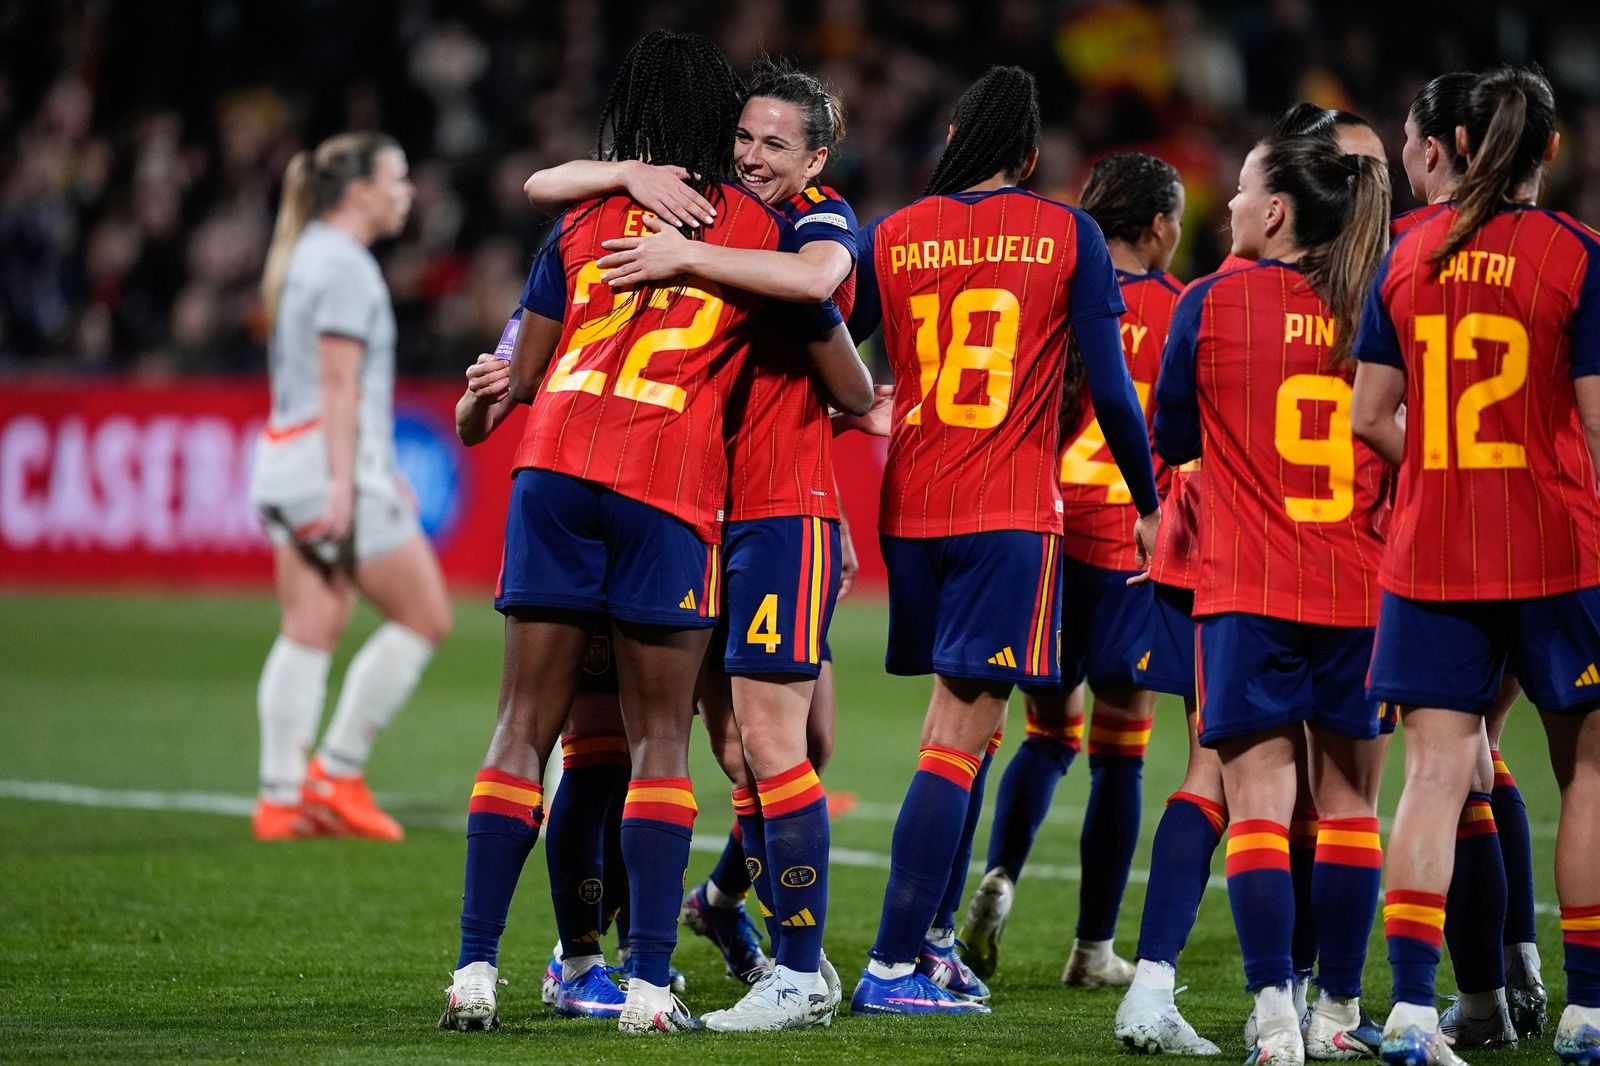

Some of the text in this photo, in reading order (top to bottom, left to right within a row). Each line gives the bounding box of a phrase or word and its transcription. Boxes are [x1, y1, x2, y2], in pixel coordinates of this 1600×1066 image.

[890, 235, 1055, 274] PARALLUELO
[1439, 250, 1516, 287] PATRI
[547, 259, 722, 413] 22
[906, 288, 1020, 430] 18
[1284, 312, 1337, 347] PIN
[1414, 312, 1529, 470] 12
[1274, 374, 1354, 522] 9
[747, 594, 781, 653] 4
